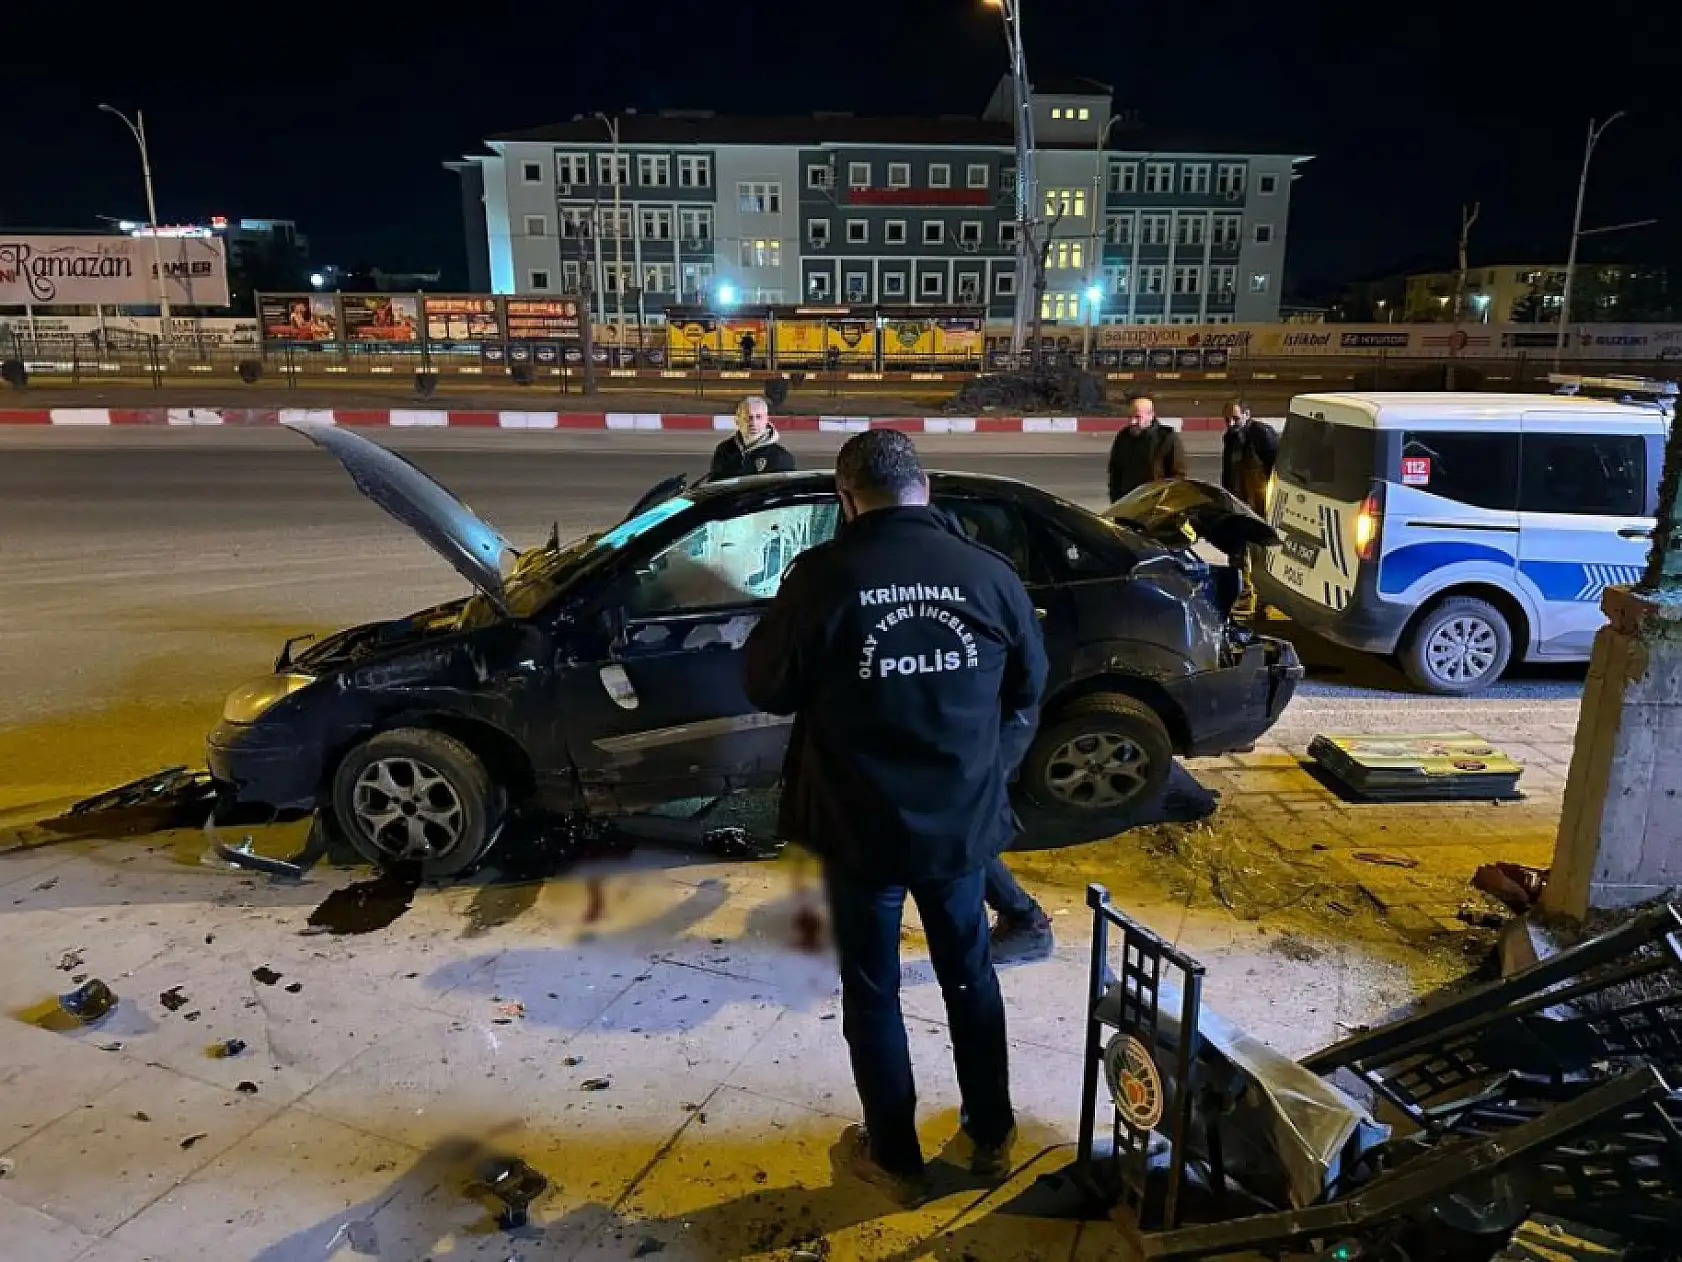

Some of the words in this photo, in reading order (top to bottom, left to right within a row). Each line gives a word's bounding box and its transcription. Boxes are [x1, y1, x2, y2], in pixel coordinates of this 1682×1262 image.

[4, 243, 132, 301] Ramazan
[1406, 461, 1426, 474] 112
[859, 633, 878, 679] OLAY
[880, 649, 961, 678] POLİS
